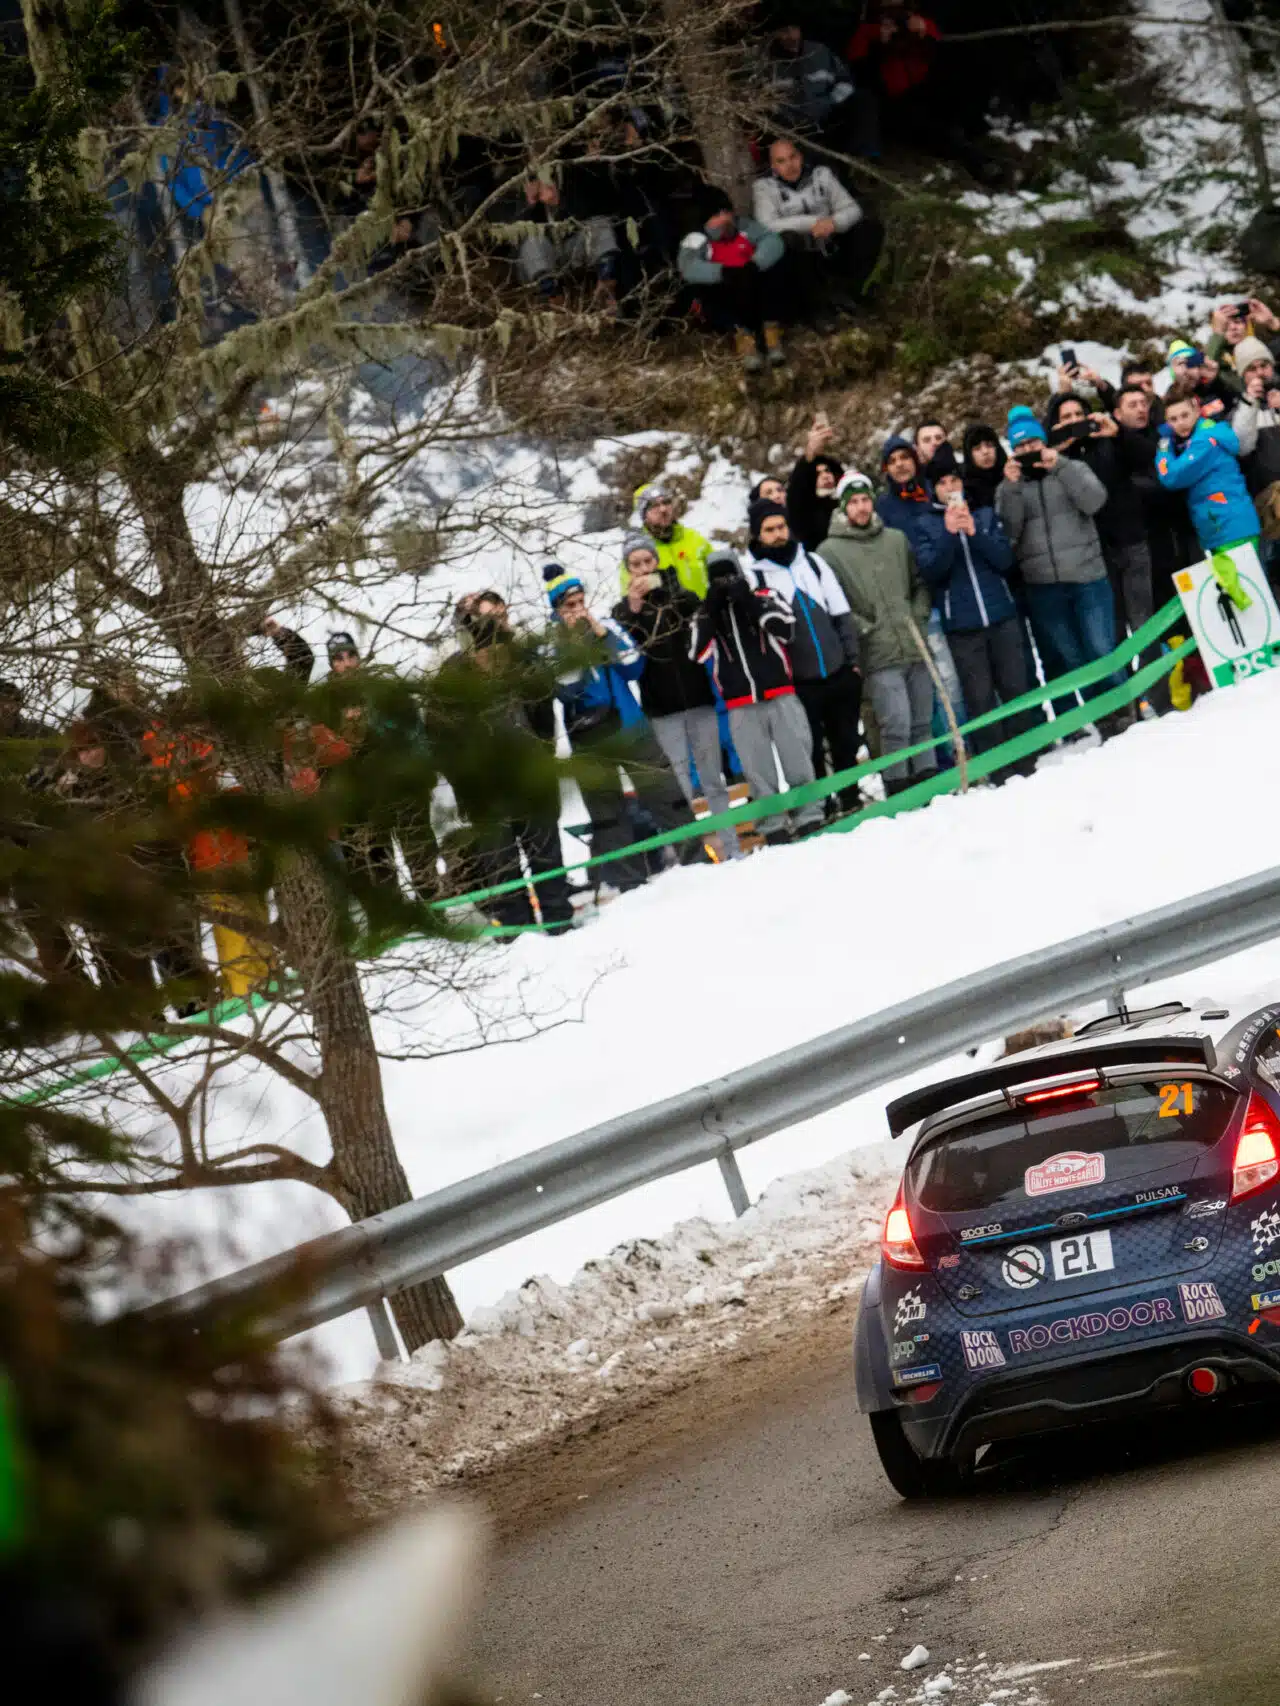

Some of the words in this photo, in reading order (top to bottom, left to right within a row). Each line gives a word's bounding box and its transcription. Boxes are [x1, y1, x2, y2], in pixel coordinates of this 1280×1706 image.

[1158, 1082, 1194, 1119] 21
[1135, 1185, 1182, 1204] PULSAR
[960, 1223, 1003, 1240] sparco
[1060, 1236, 1097, 1276] 21
[1181, 1284, 1217, 1301] ROCK
[1184, 1298, 1225, 1320] DOOR
[1008, 1298, 1176, 1354] ROCKDOOR
[963, 1331, 997, 1348] ROCK
[966, 1346, 1005, 1369] DOOR
